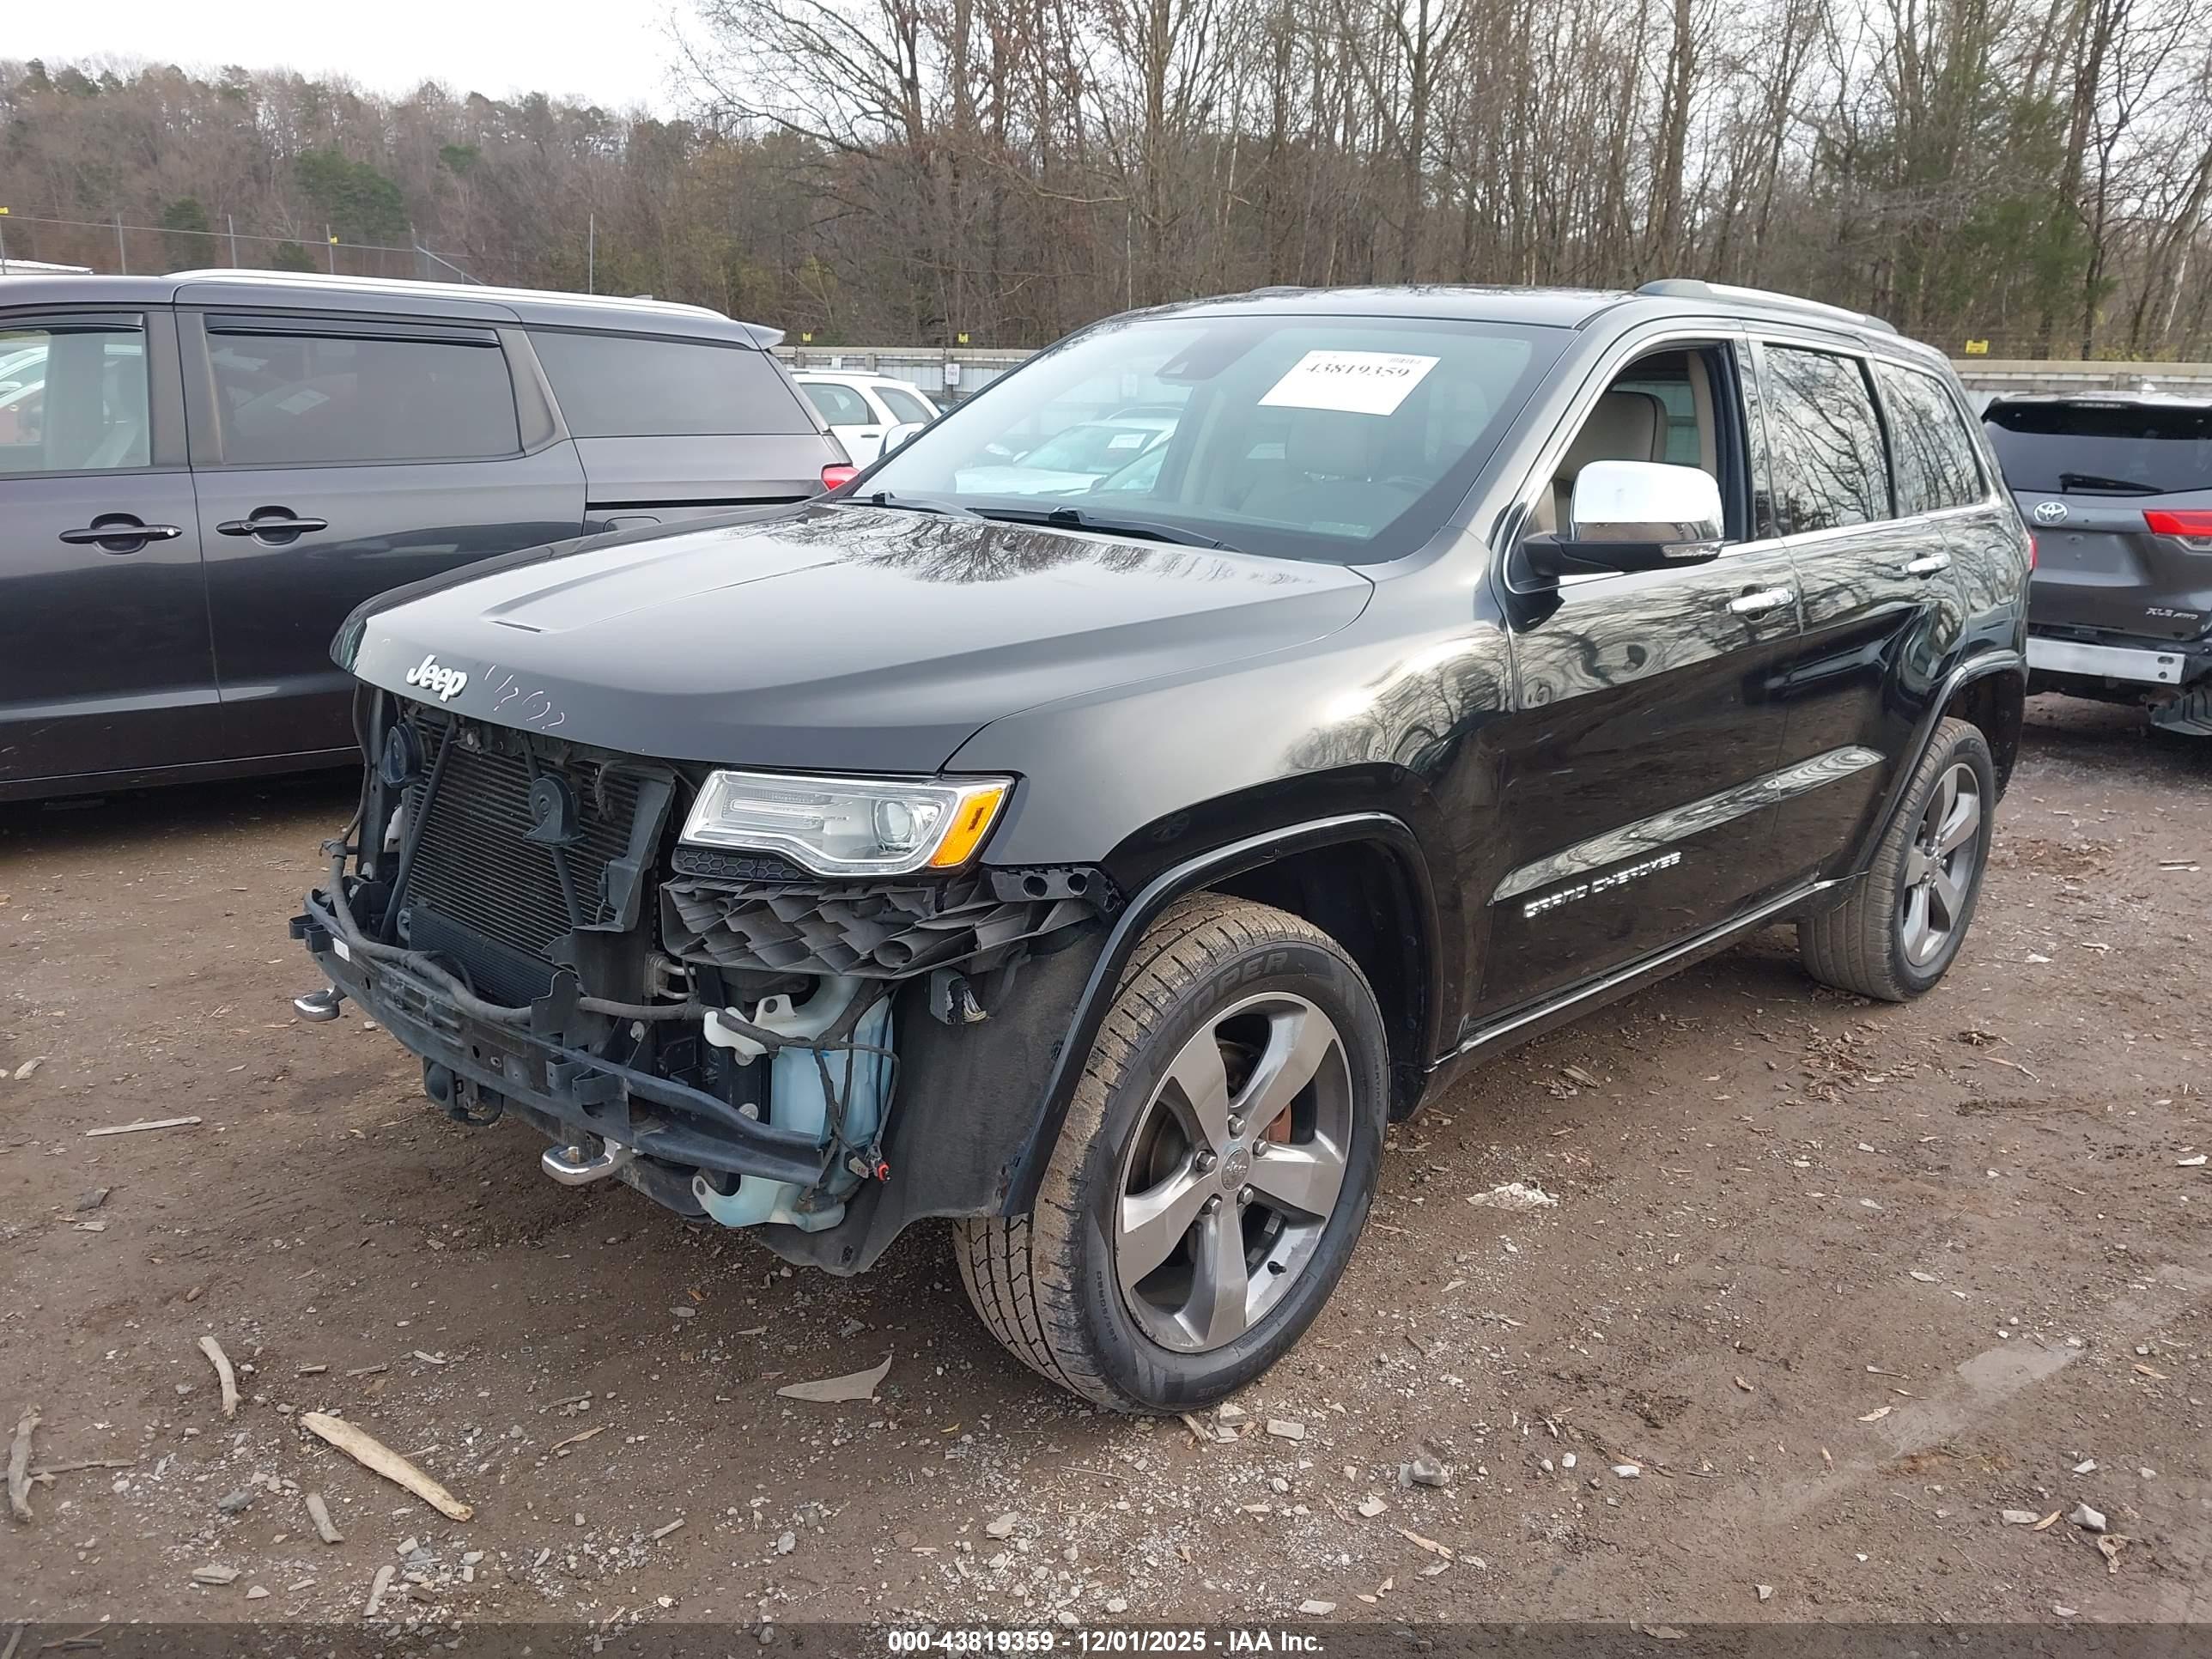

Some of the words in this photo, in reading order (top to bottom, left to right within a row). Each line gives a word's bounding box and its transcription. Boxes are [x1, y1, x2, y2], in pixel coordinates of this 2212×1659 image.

[1305, 363, 1410, 378] 43819359
[2146, 607, 2174, 617] XLE
[405, 653, 470, 703] Jeep
[1523, 884, 1589, 919] GRAND
